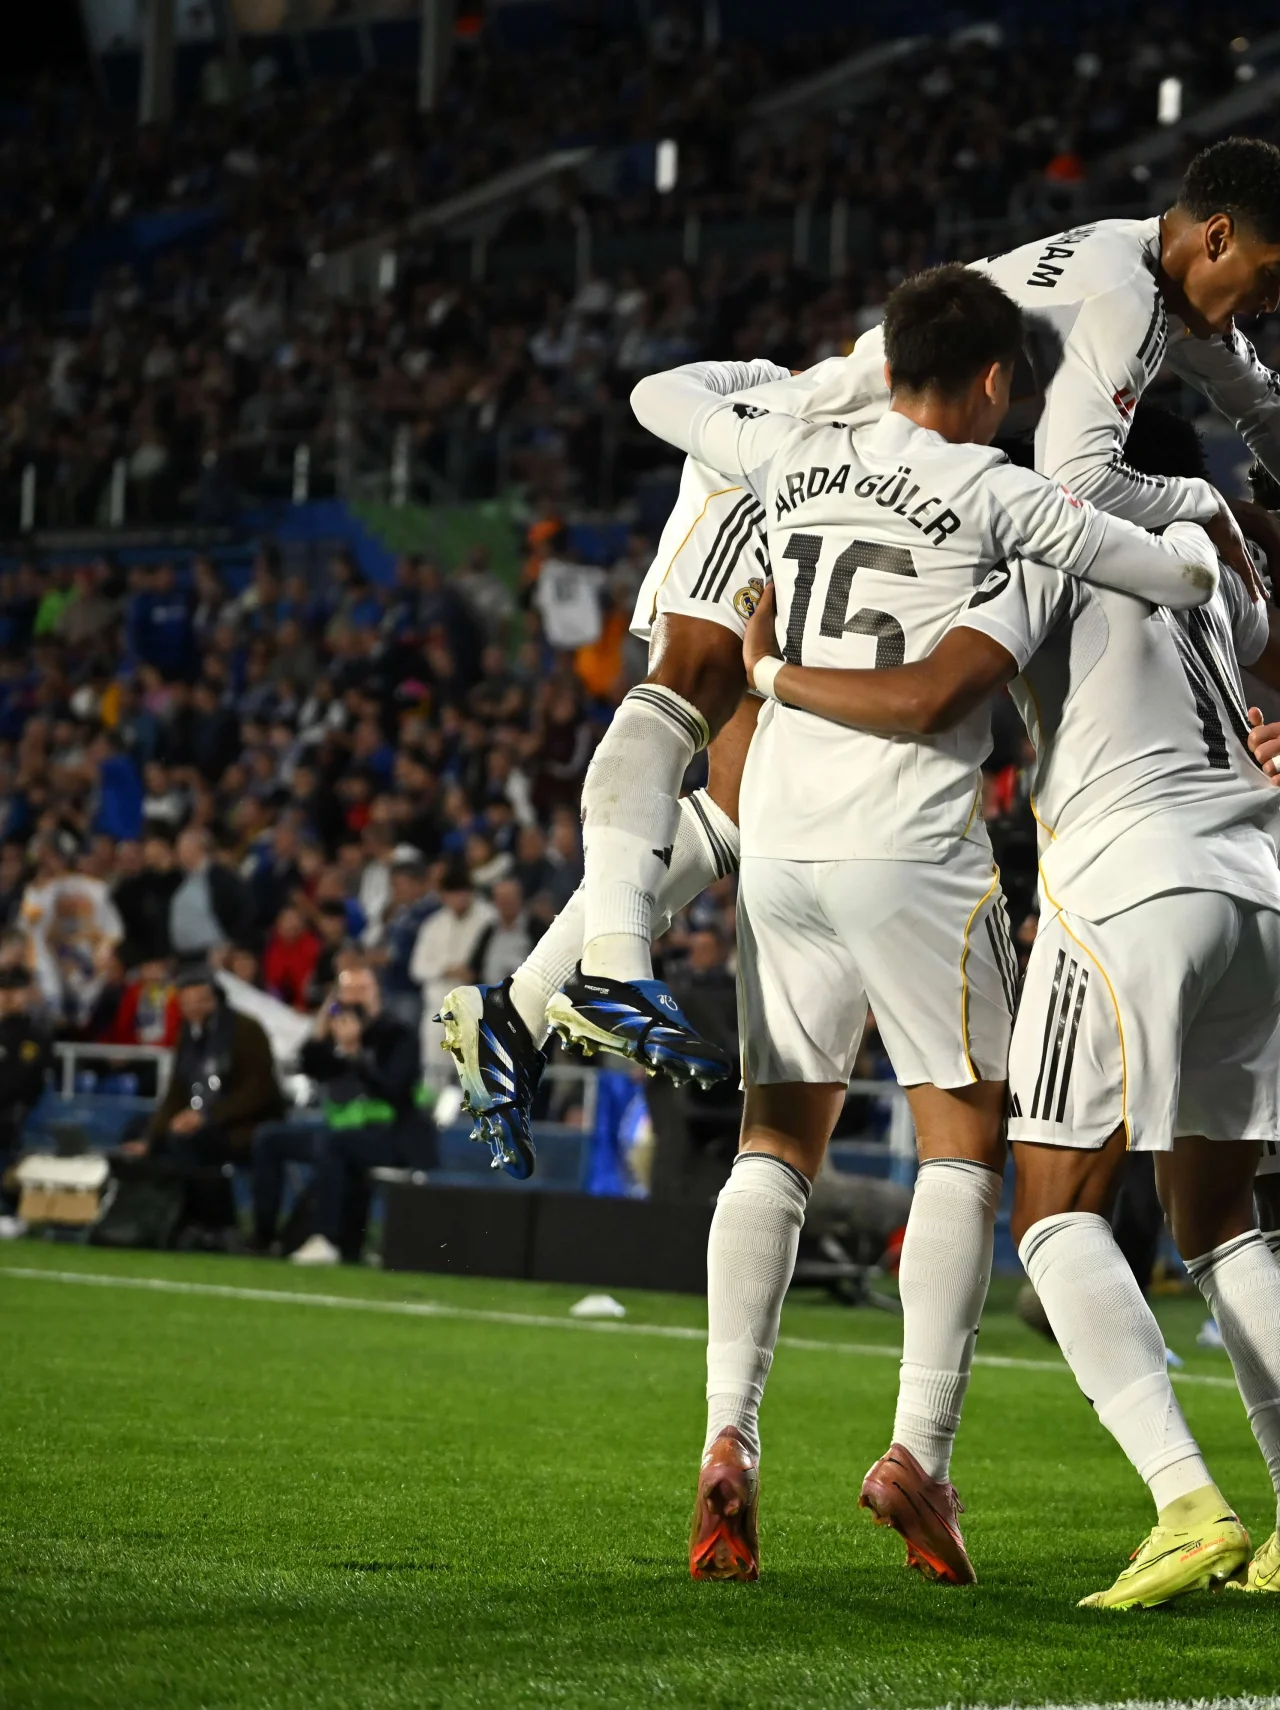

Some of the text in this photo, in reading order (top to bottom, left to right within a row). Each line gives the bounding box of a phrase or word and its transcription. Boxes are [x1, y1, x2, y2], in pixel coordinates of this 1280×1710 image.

[775, 464, 961, 546] ARDA GÜLER
[782, 532, 918, 711] 15
